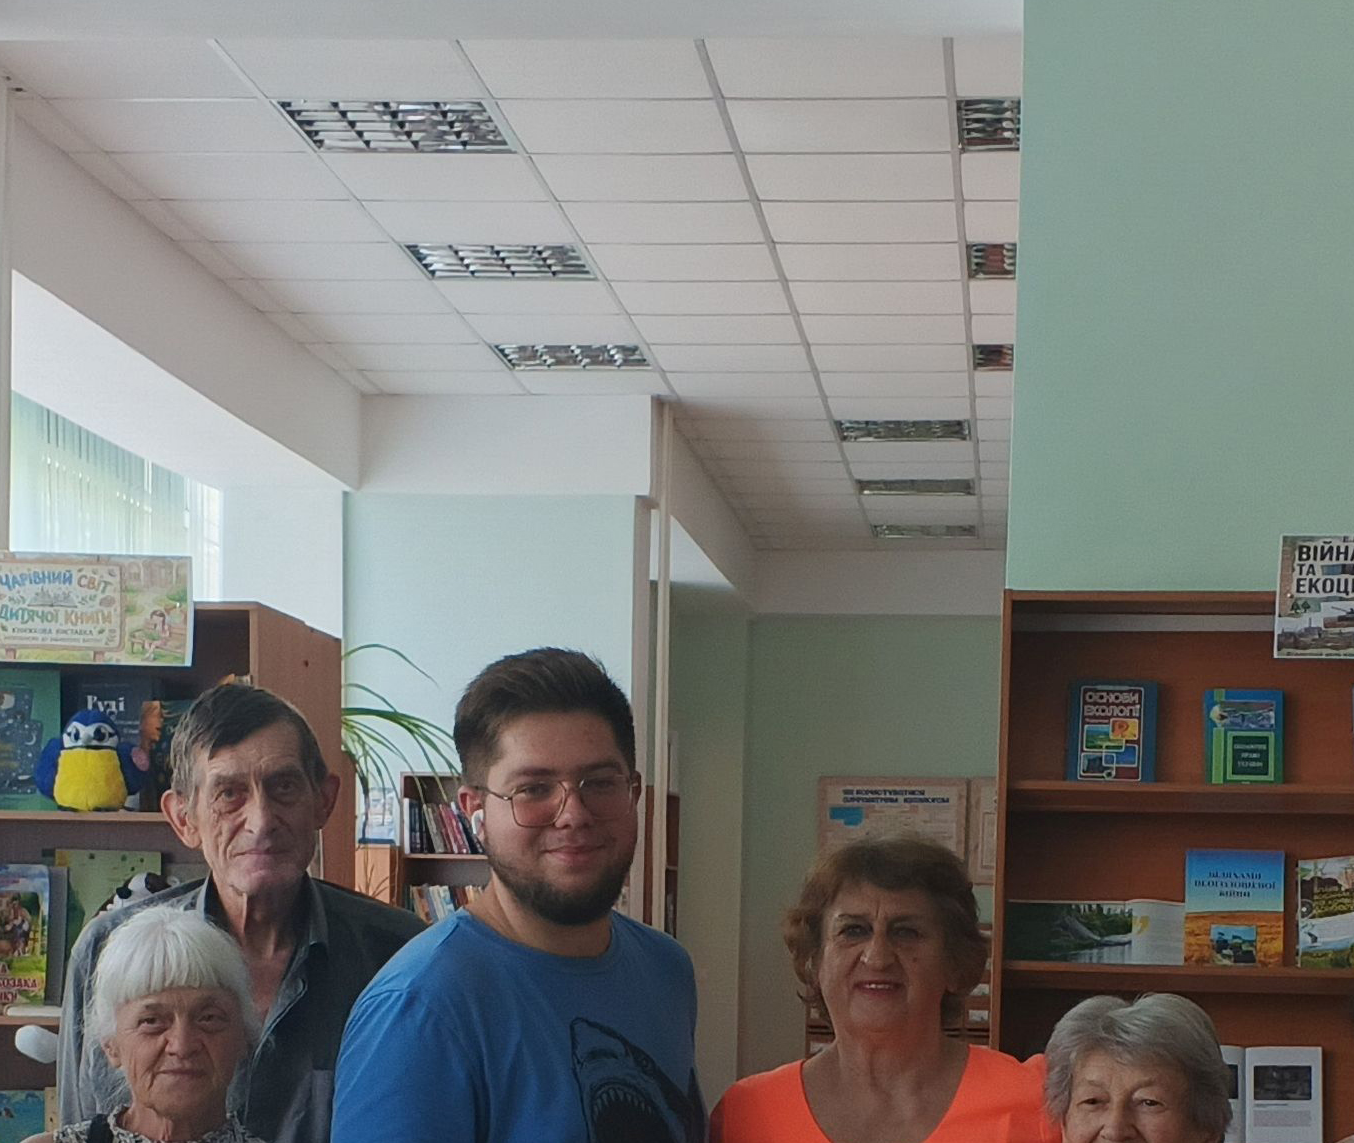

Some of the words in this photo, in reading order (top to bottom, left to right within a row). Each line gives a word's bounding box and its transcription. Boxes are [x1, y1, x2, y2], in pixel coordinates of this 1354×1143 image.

[1297, 564, 1316, 576] ТА
[77, 574, 114, 594] СВІТ
[64, 609, 112, 626] КНИГИ
[1085, 691, 1139, 704] ОСНОВИ
